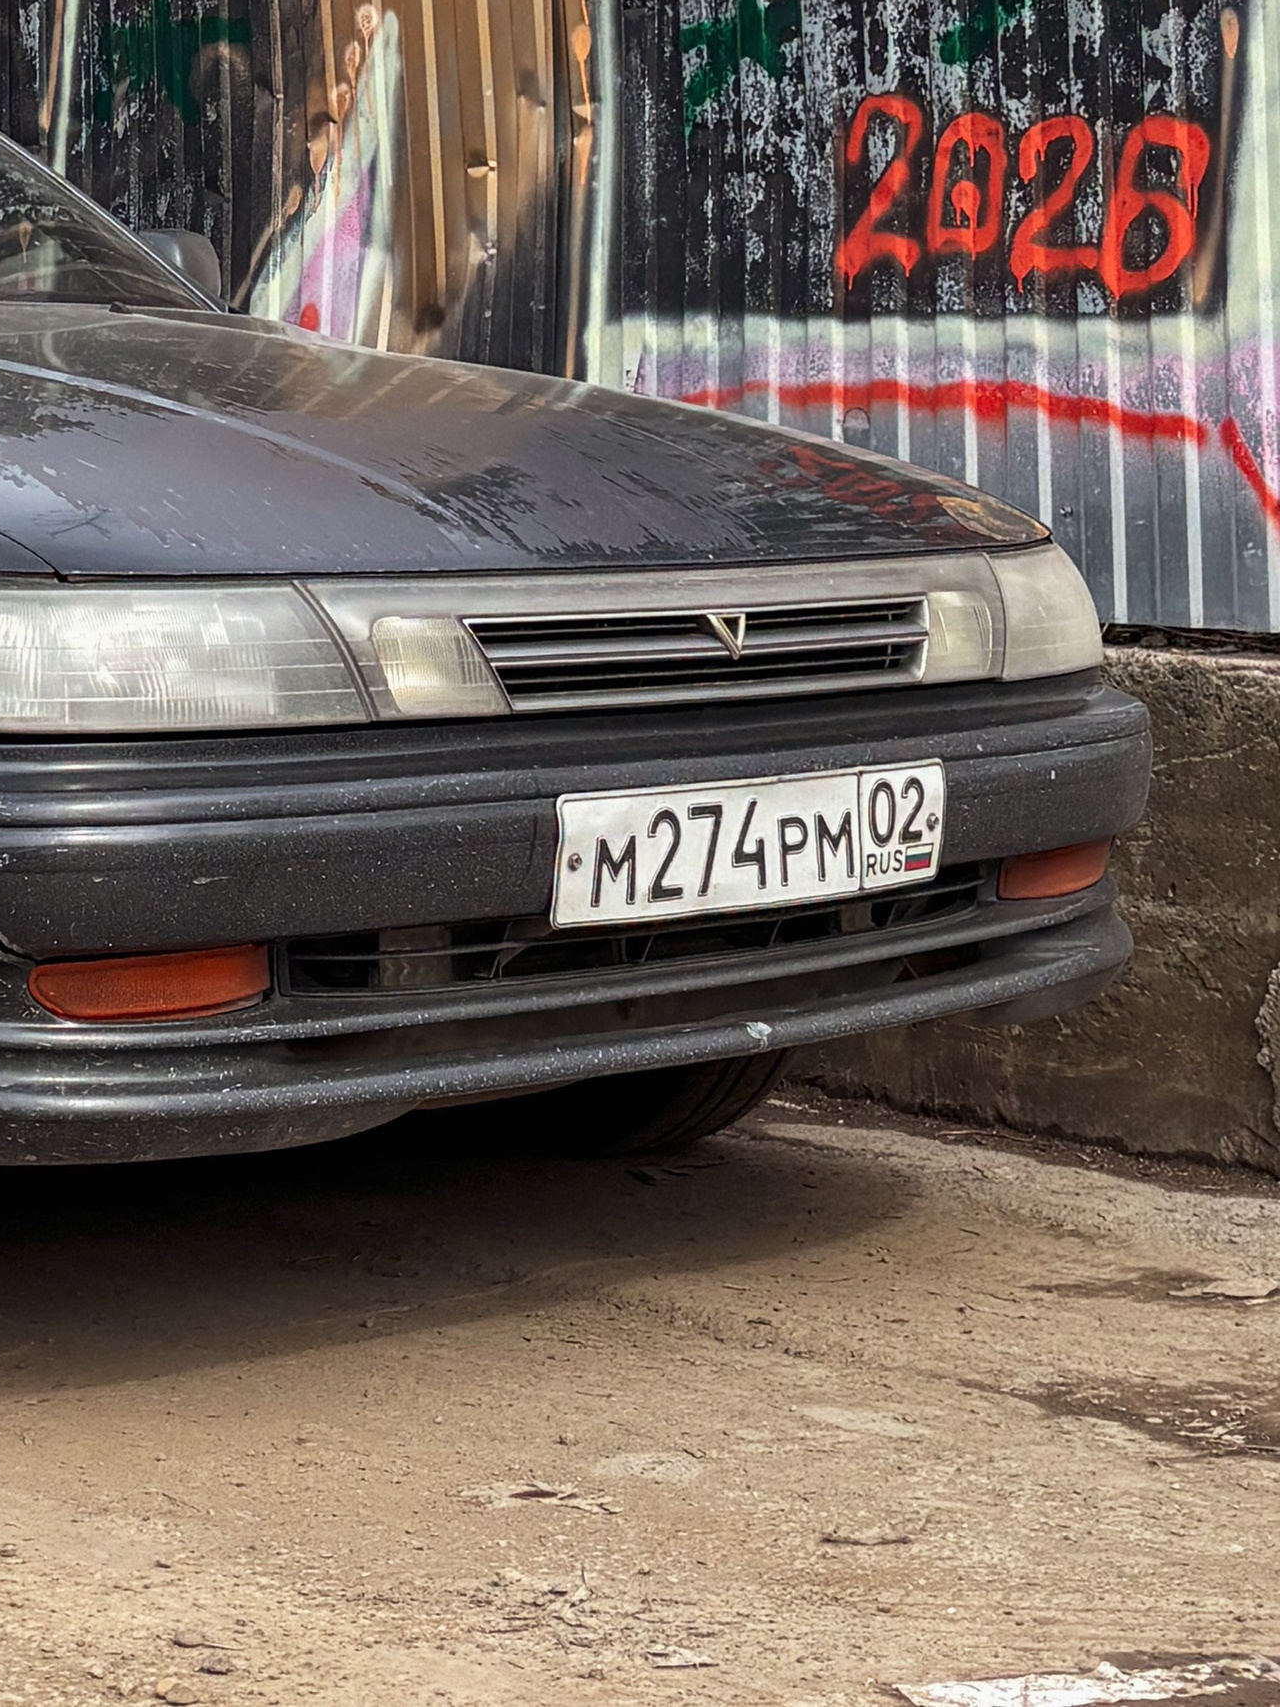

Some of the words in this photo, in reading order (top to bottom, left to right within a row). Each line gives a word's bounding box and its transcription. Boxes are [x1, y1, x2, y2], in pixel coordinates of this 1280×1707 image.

[835, 95, 1210, 299] 2026
[590, 798, 857, 908] М274РМ
[868, 776, 927, 848] 02
[865, 849, 904, 878] RUS
